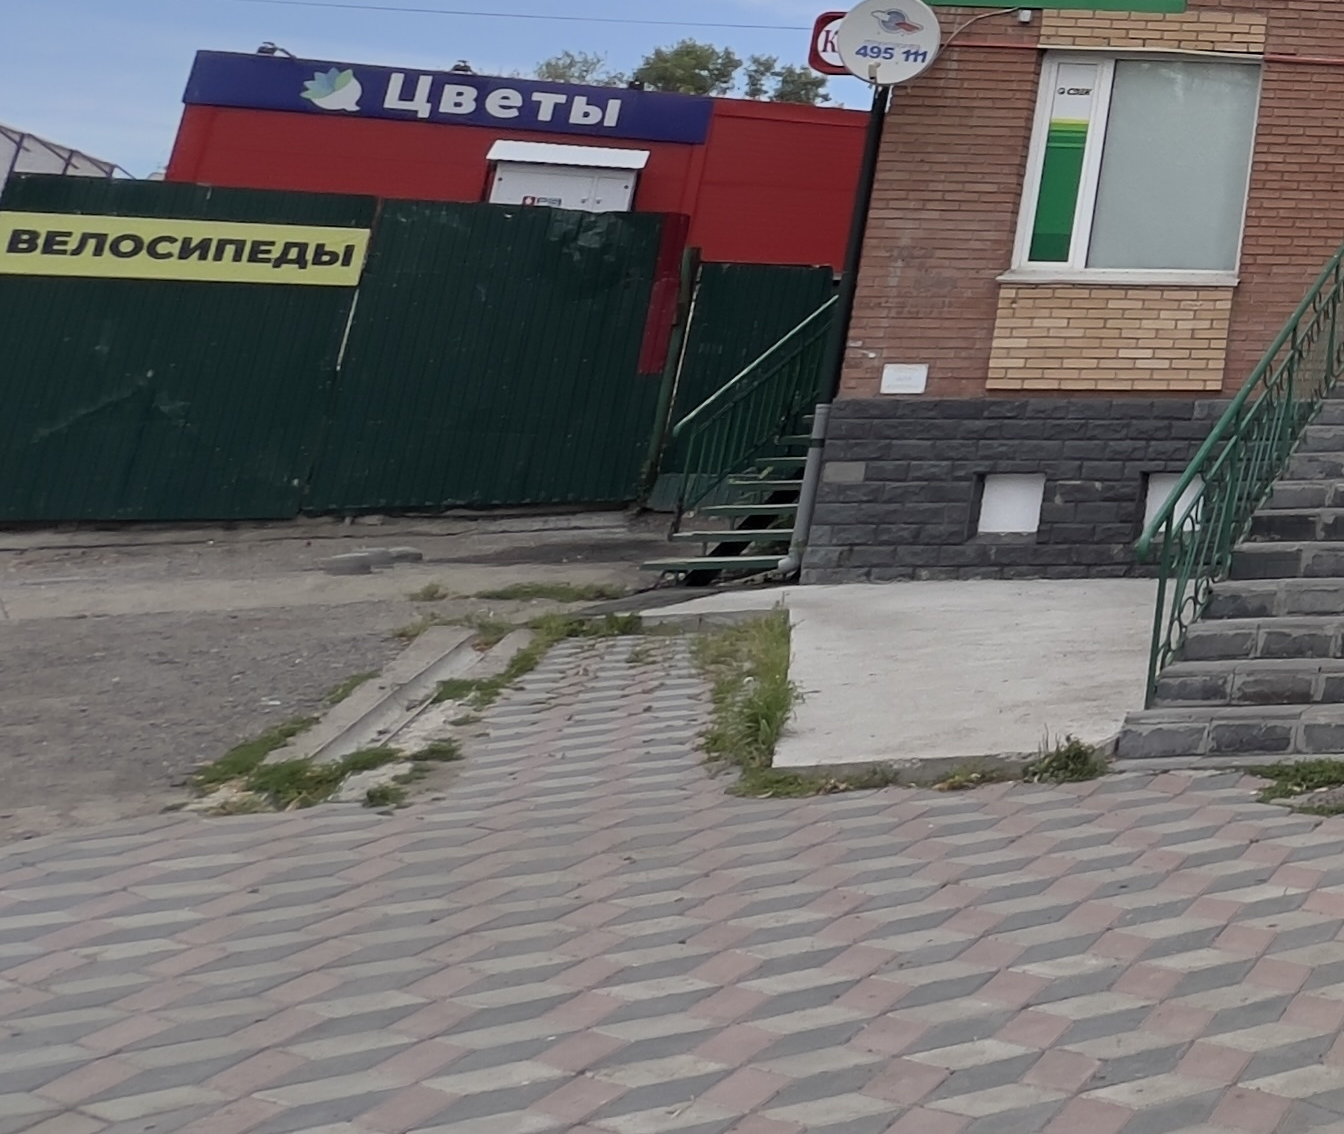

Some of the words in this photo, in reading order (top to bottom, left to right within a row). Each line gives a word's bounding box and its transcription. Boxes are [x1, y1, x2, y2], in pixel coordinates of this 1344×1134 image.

[855, 45, 895, 60] 495
[901, 48, 928, 63] 111
[383, 72, 622, 127] Цветы
[6, 228, 356, 269] ВЕЛОСИПЕДЫ
